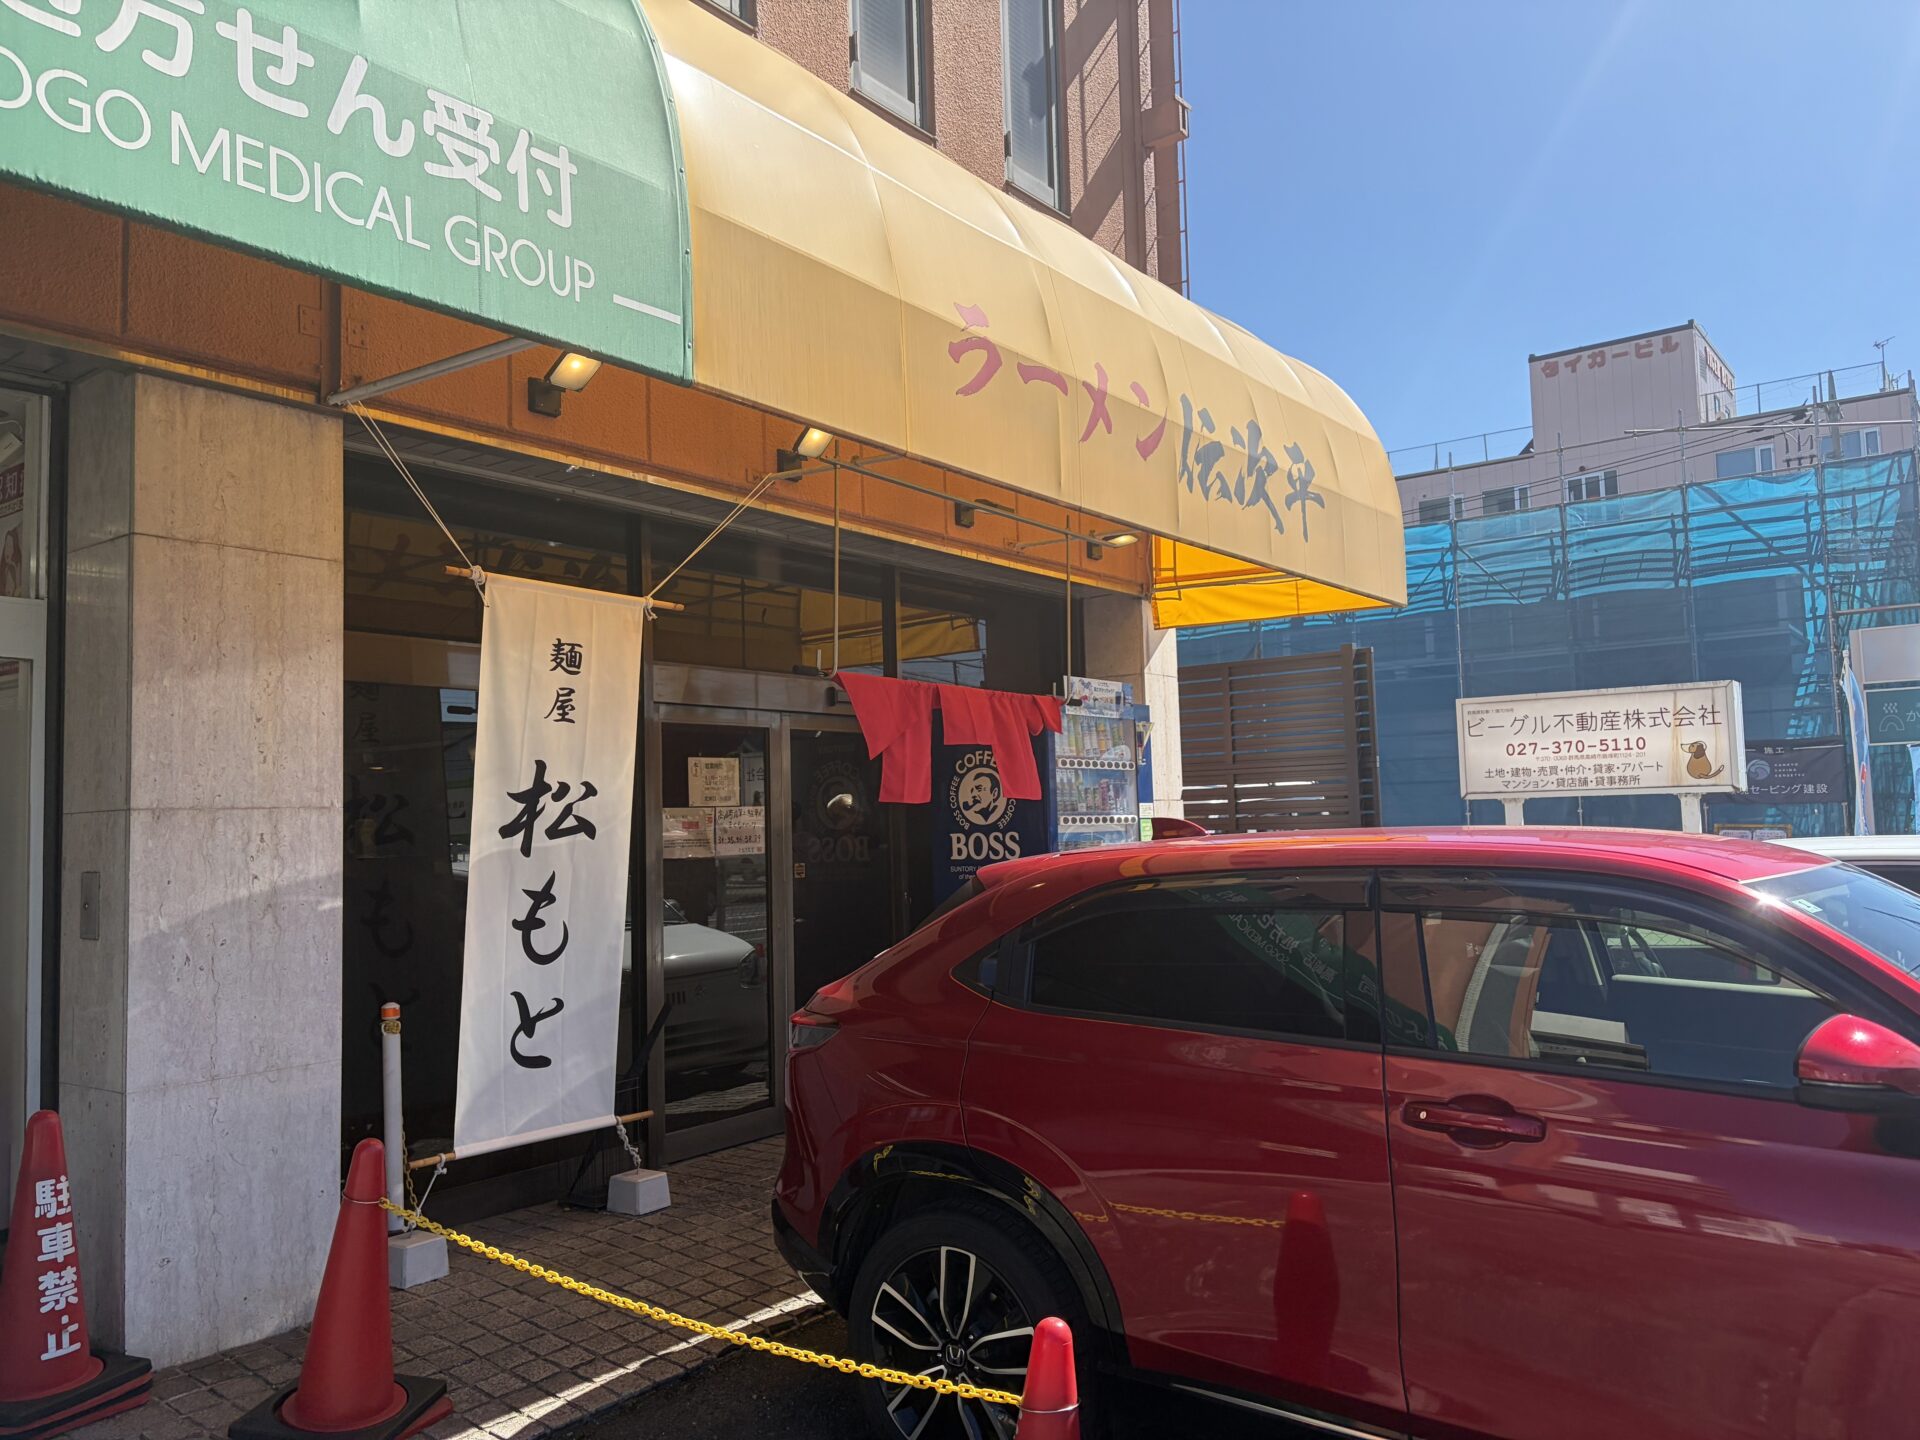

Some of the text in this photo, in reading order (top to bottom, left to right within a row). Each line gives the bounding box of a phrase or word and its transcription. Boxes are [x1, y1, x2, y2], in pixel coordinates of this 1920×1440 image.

[170, 111, 430, 250] MEDICAL
[444, 215, 595, 302] GROUP
[1540, 335, 1680, 378] タイガービル
[948, 302, 1168, 462] ラーメン
[1467, 704, 1722, 738] ビーグル不動産株式会社
[956, 750, 998, 773] COFFE
[1505, 736, 1646, 757] 027-370-5110
[949, 775, 970, 830] BOSS COFFEE
[998, 798, 1016, 830] COFFEE
[498, 638, 598, 1070] 麺屋 松もと
[950, 831, 1021, 860] BOSS
[35, 1175, 81, 1361] 駐車禁止
